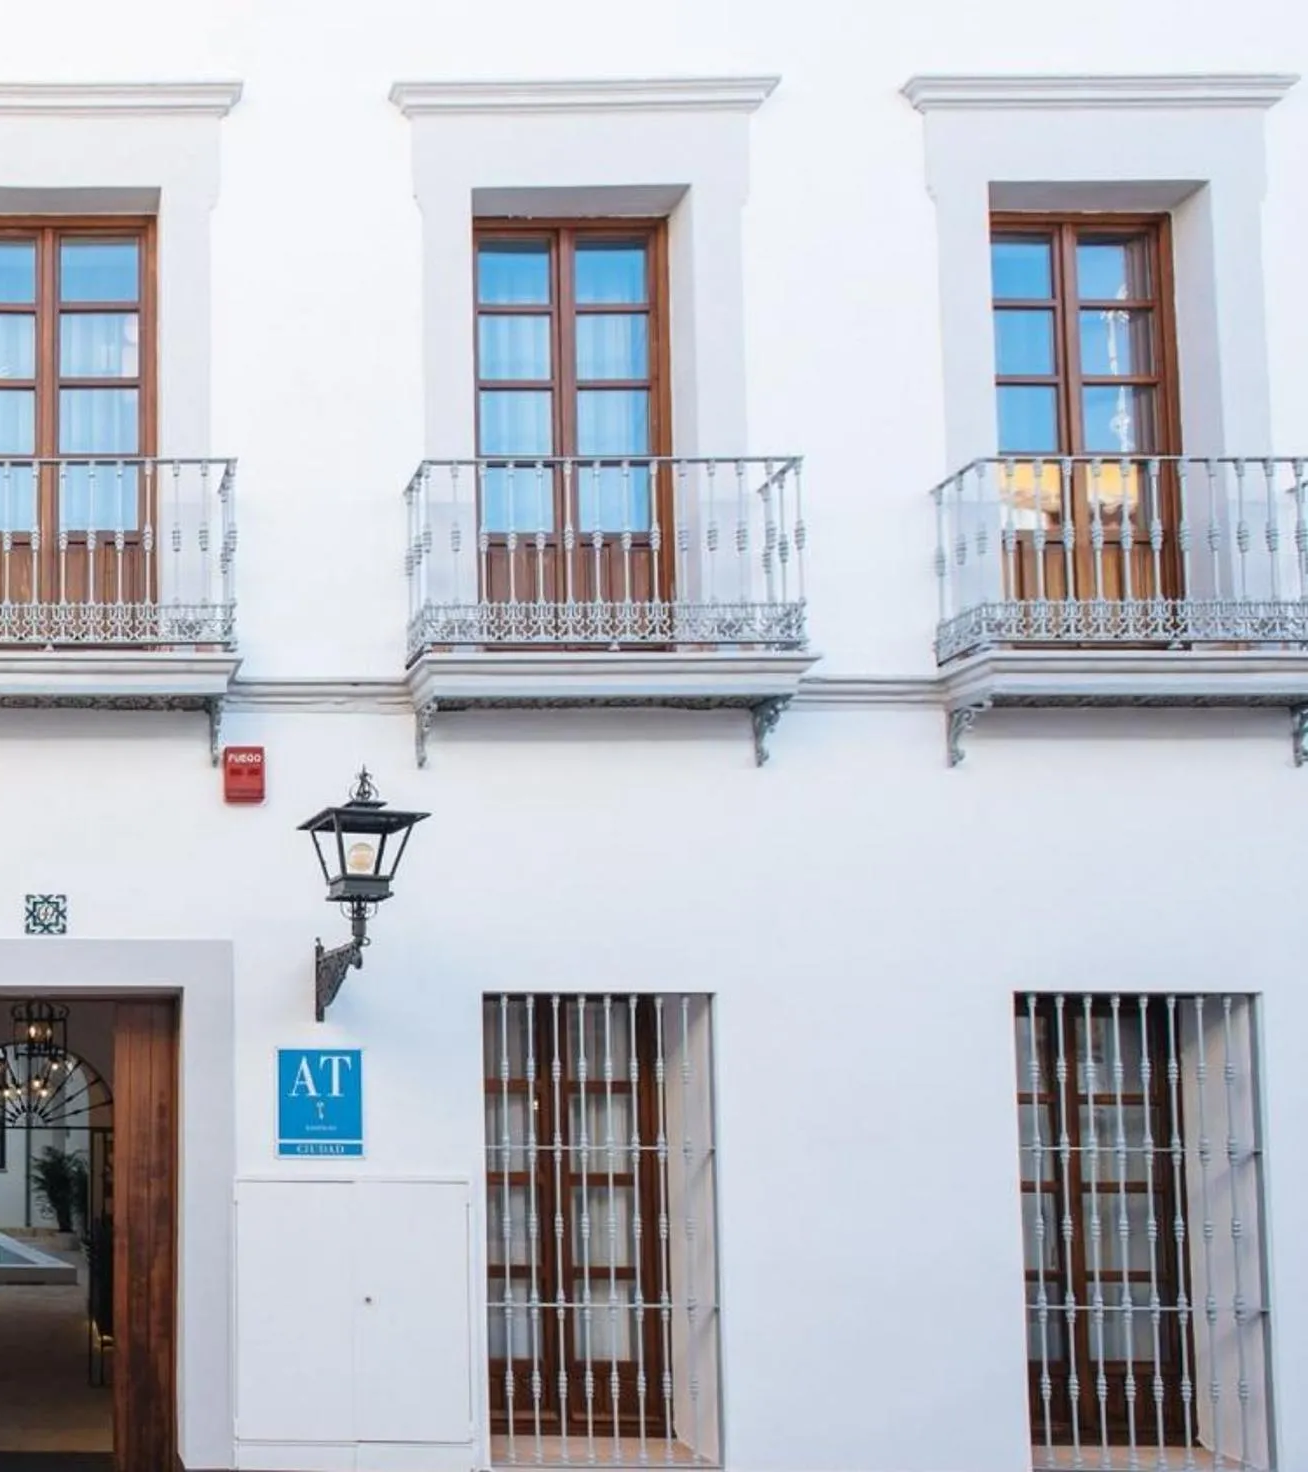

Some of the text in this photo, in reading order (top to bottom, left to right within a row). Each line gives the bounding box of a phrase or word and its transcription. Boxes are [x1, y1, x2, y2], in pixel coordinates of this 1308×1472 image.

[227, 753, 262, 763] FUEGO
[287, 1055, 352, 1097] AT
[296, 1144, 344, 1154] CIUDAD
